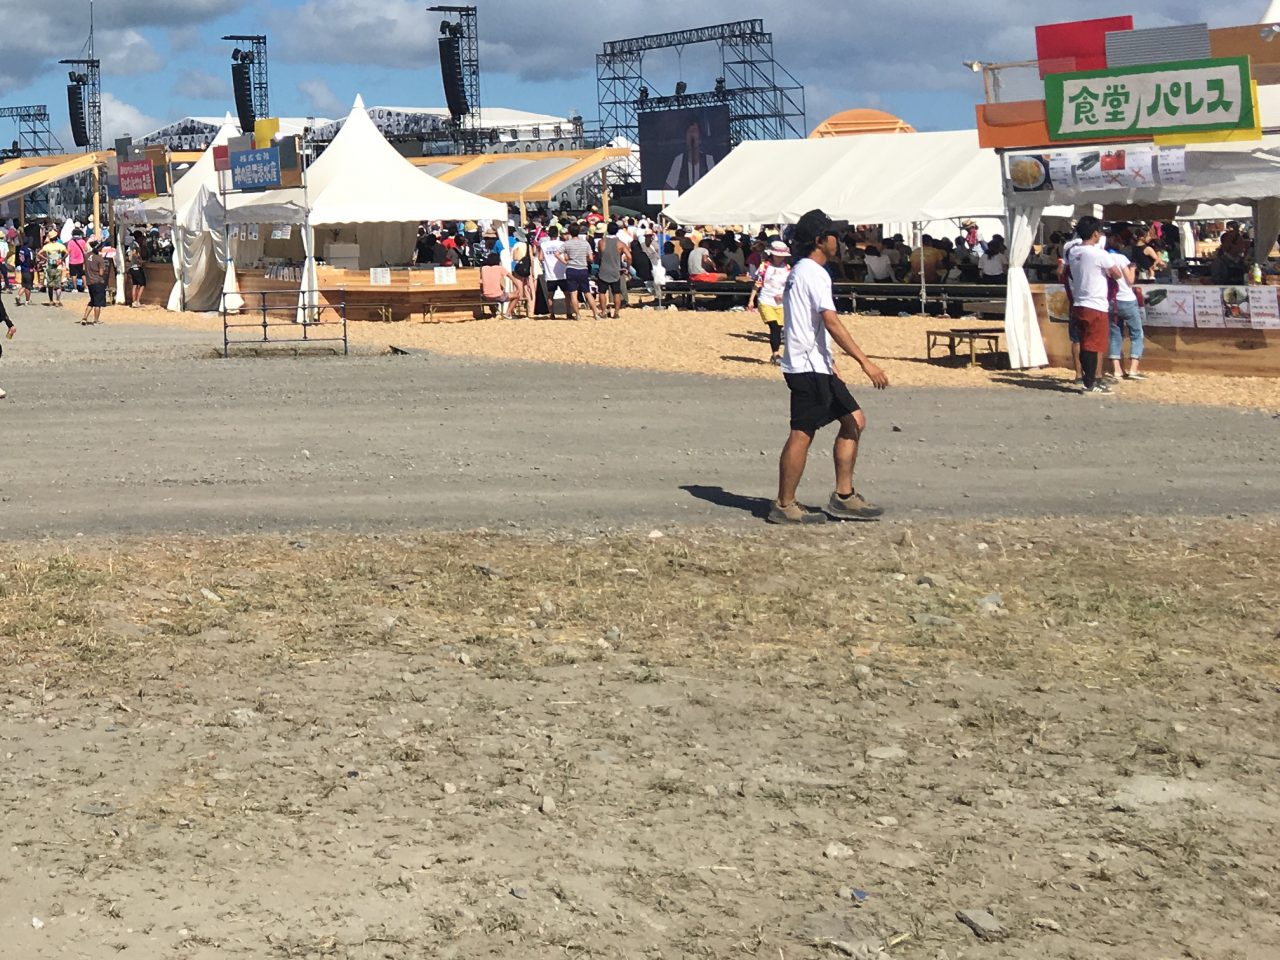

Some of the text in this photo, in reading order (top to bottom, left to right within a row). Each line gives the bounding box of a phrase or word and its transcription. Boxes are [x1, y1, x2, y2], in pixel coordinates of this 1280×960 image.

[1068, 78, 1234, 126] 食堂 パレス
